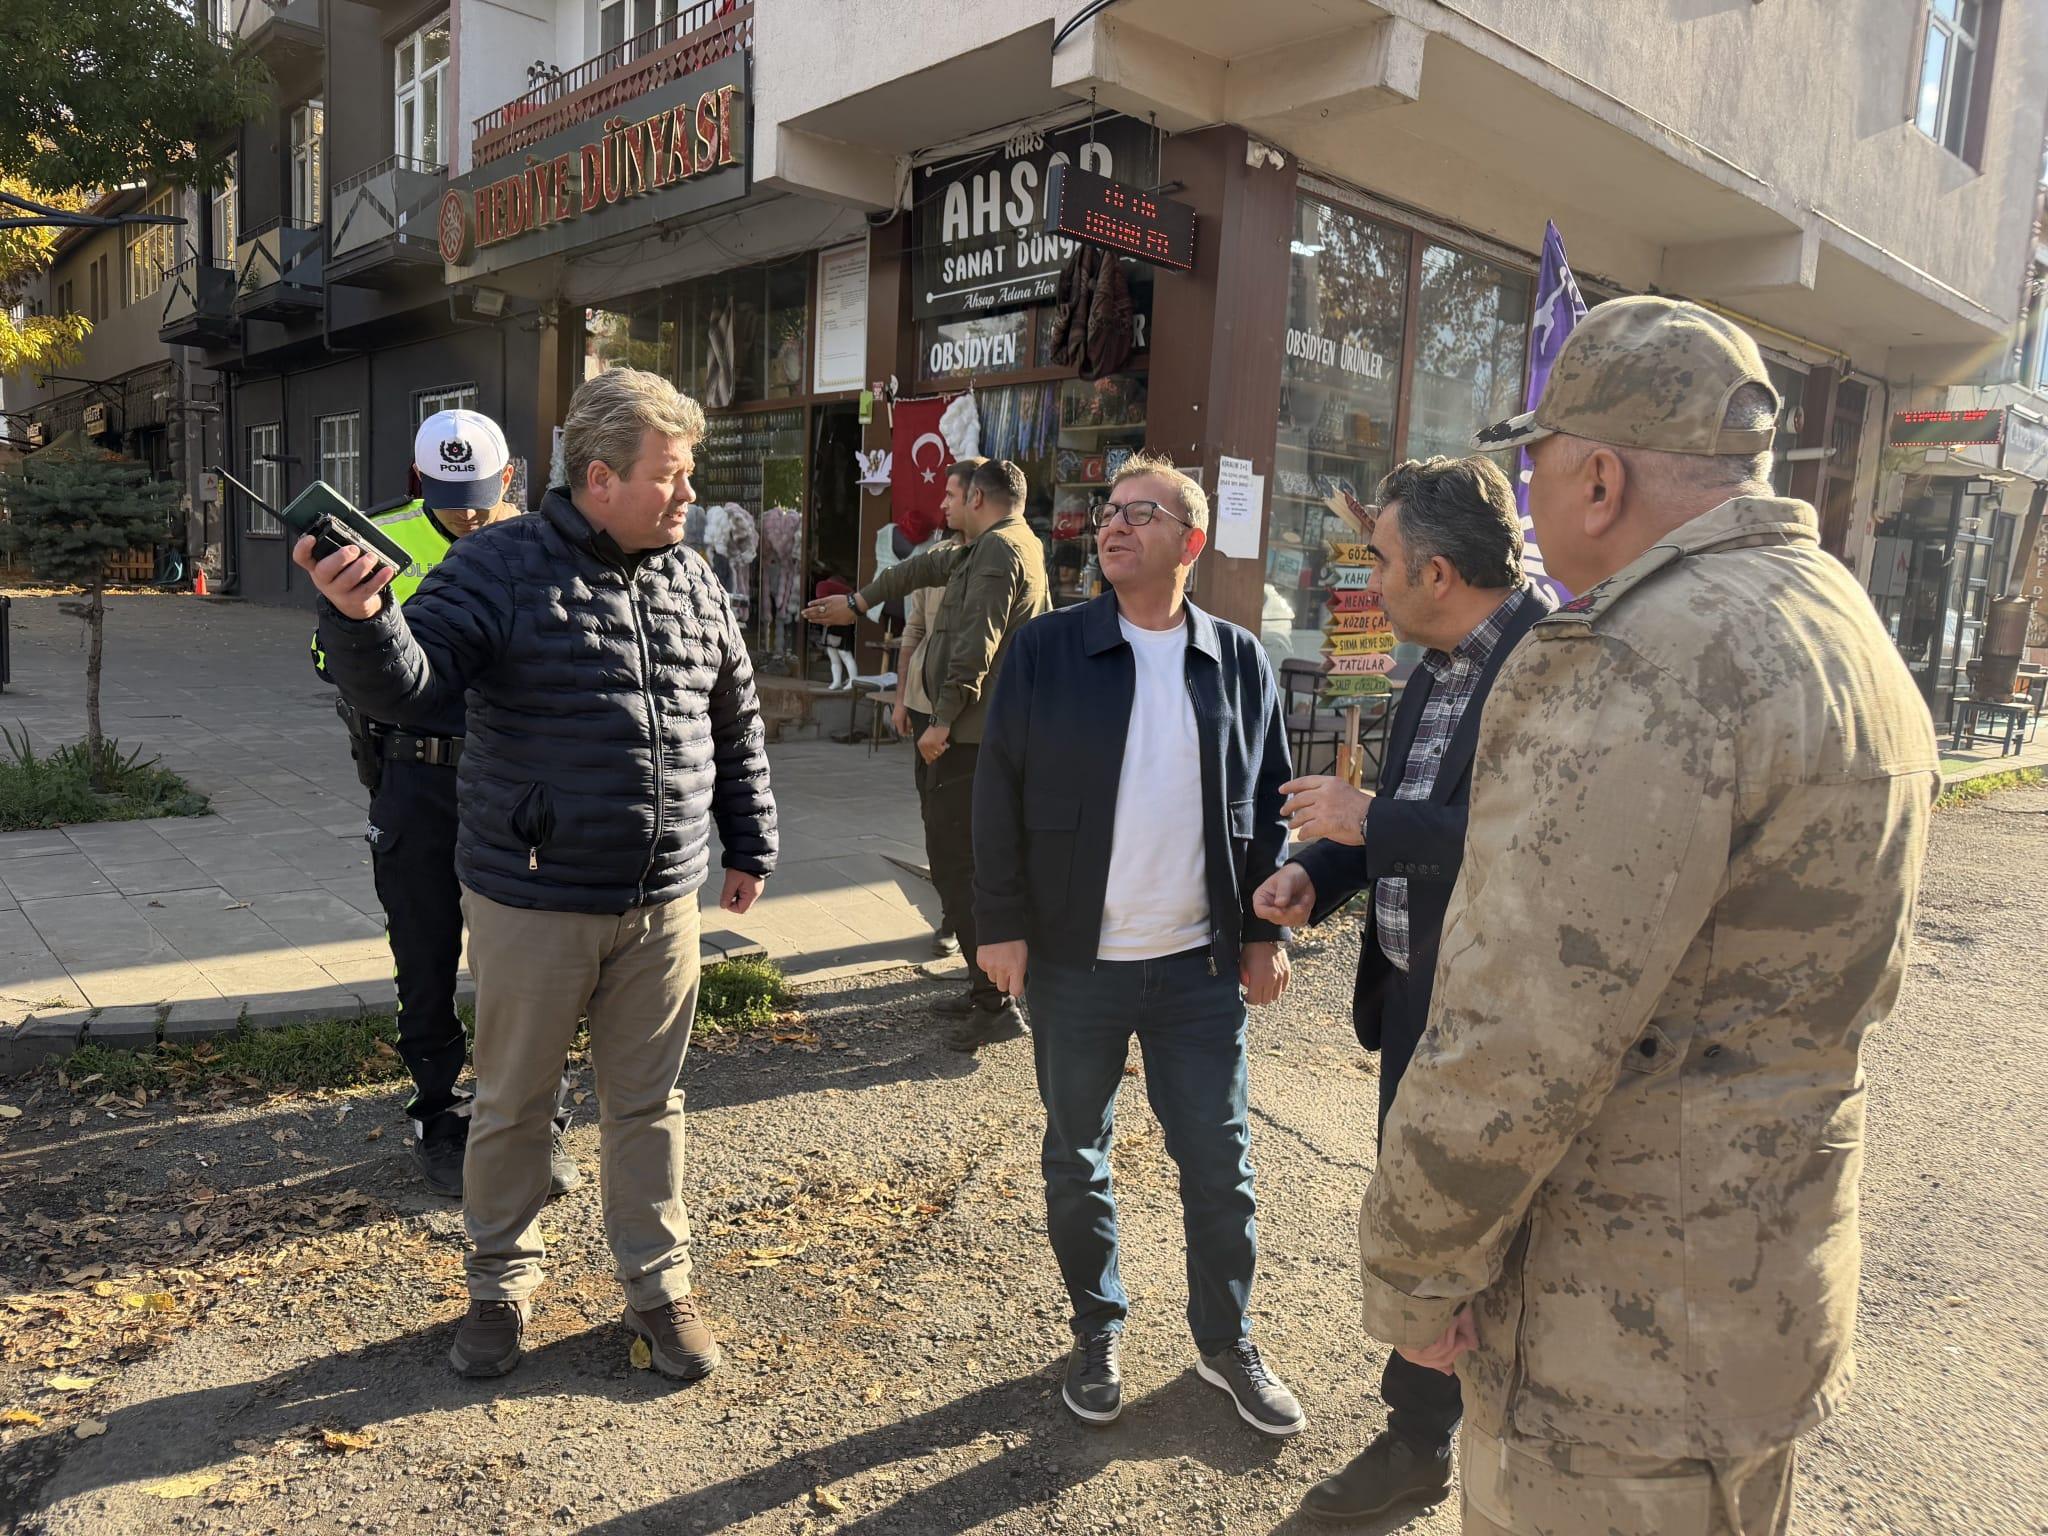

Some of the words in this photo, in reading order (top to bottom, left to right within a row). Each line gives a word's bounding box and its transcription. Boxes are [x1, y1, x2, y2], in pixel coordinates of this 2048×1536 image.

[1005, 131, 1045, 159] KARS
[474, 153, 572, 247] HEDİYE
[580, 85, 738, 213] DÜNYASI
[943, 245, 1006, 284] SANAT
[1017, 231, 1083, 268] DÜNY
[930, 332, 1016, 373] OBSİDYEN
[1286, 327, 1336, 367] OBSİDYEN
[1340, 338, 1383, 380] ÜRÜNLER
[1344, 573, 1371, 584] KAHV
[1344, 595, 1379, 608] MENEM
